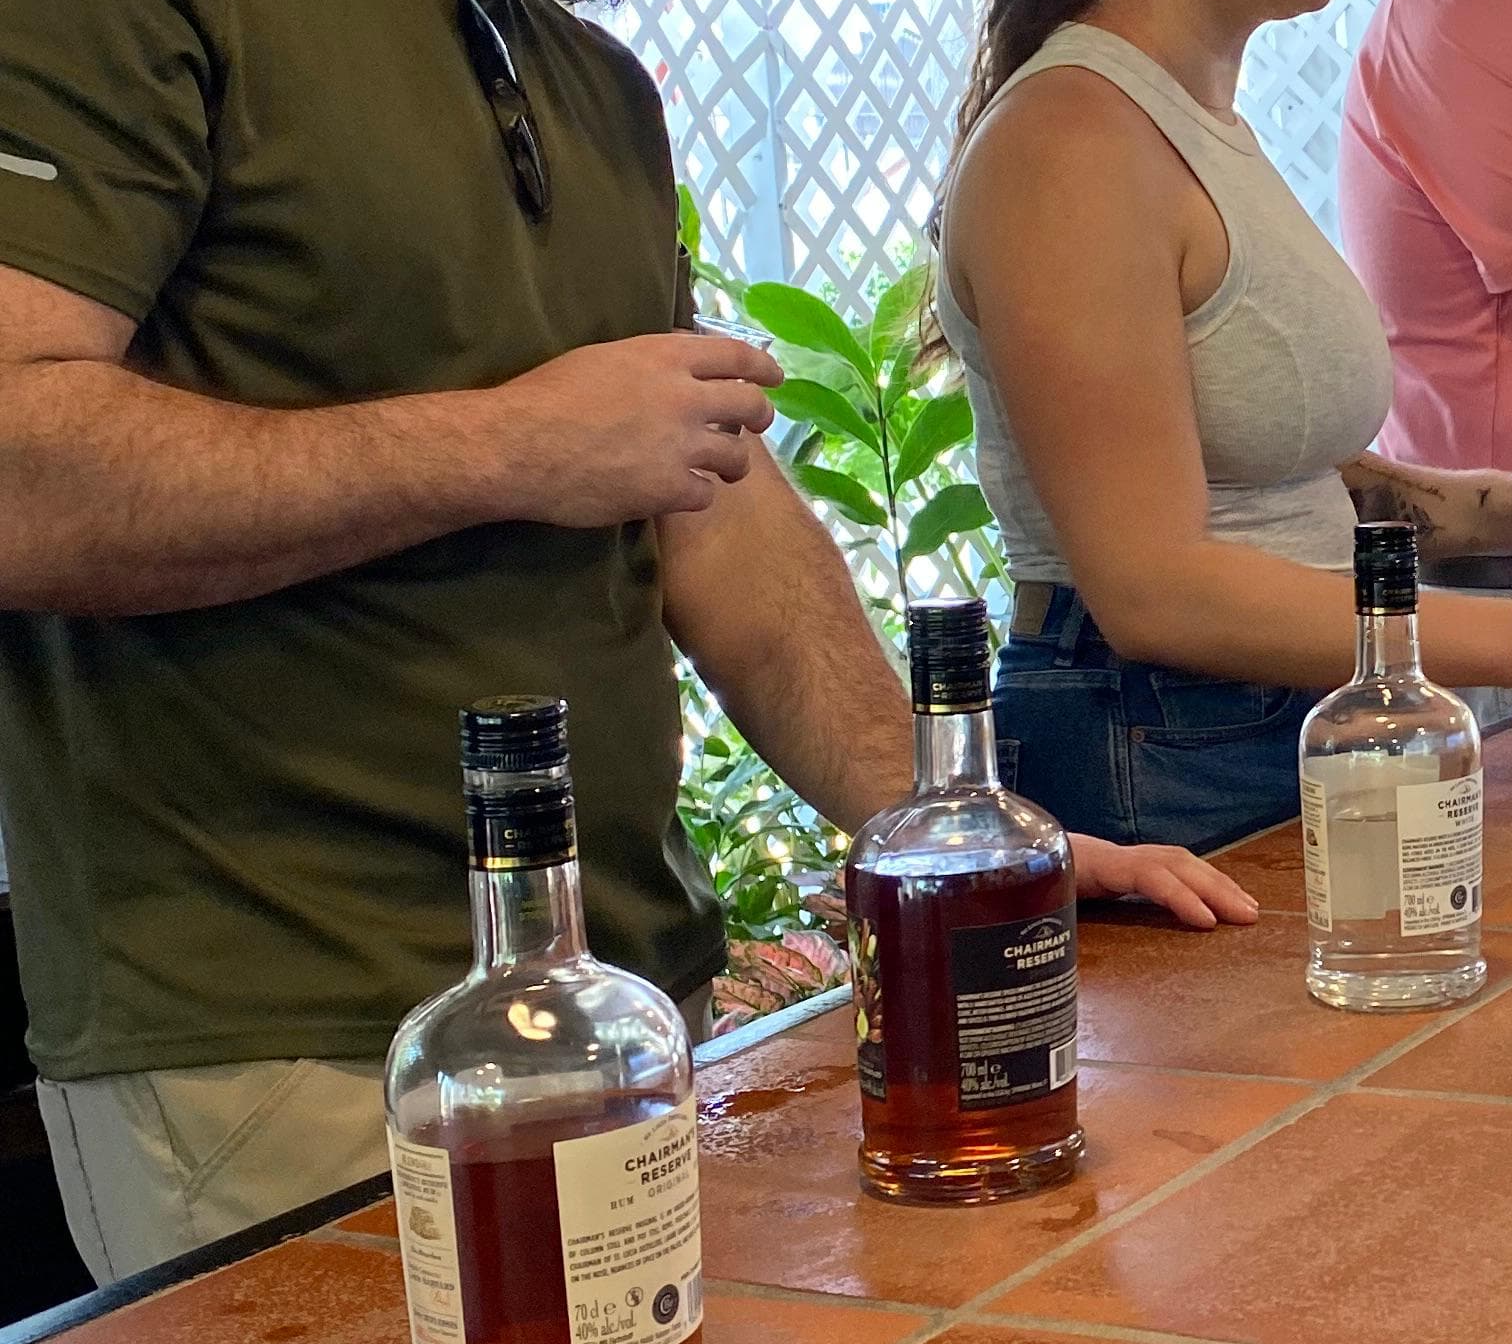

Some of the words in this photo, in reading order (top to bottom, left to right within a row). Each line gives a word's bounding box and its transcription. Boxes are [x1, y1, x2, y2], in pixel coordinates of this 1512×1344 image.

[1016, 945, 1066, 971] RESERVE
[640, 1147, 693, 1186] RESERVE
[647, 1170, 690, 1199] ORIGINAL
[610, 1195, 635, 1210] RUM
[575, 1303, 588, 1321] 70
[575, 1321, 599, 1341] 40%
